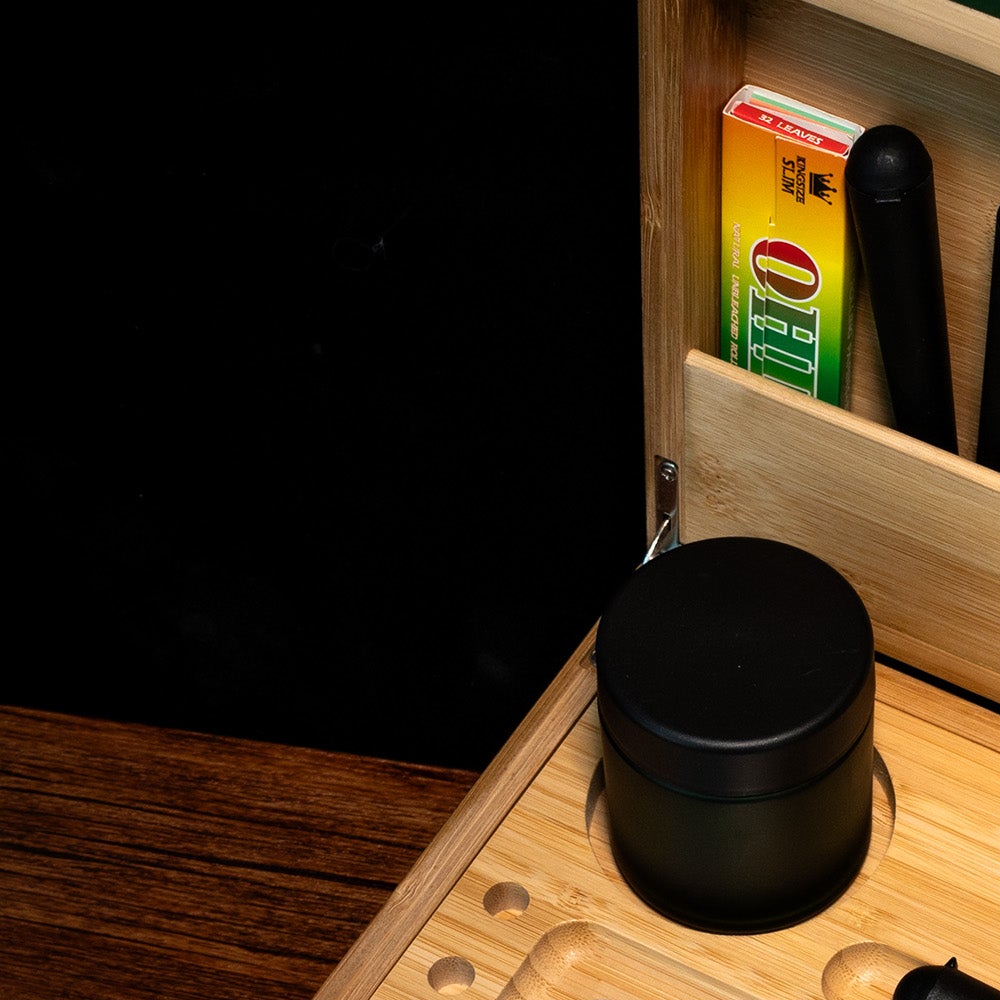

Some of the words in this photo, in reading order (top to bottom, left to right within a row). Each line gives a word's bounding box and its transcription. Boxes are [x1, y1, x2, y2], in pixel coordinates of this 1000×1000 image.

[758, 114, 773, 125] 32
[776, 121, 823, 145] LEAVES
[781, 157, 795, 195] SLIM
[796, 155, 806, 205] KINGSIZE
